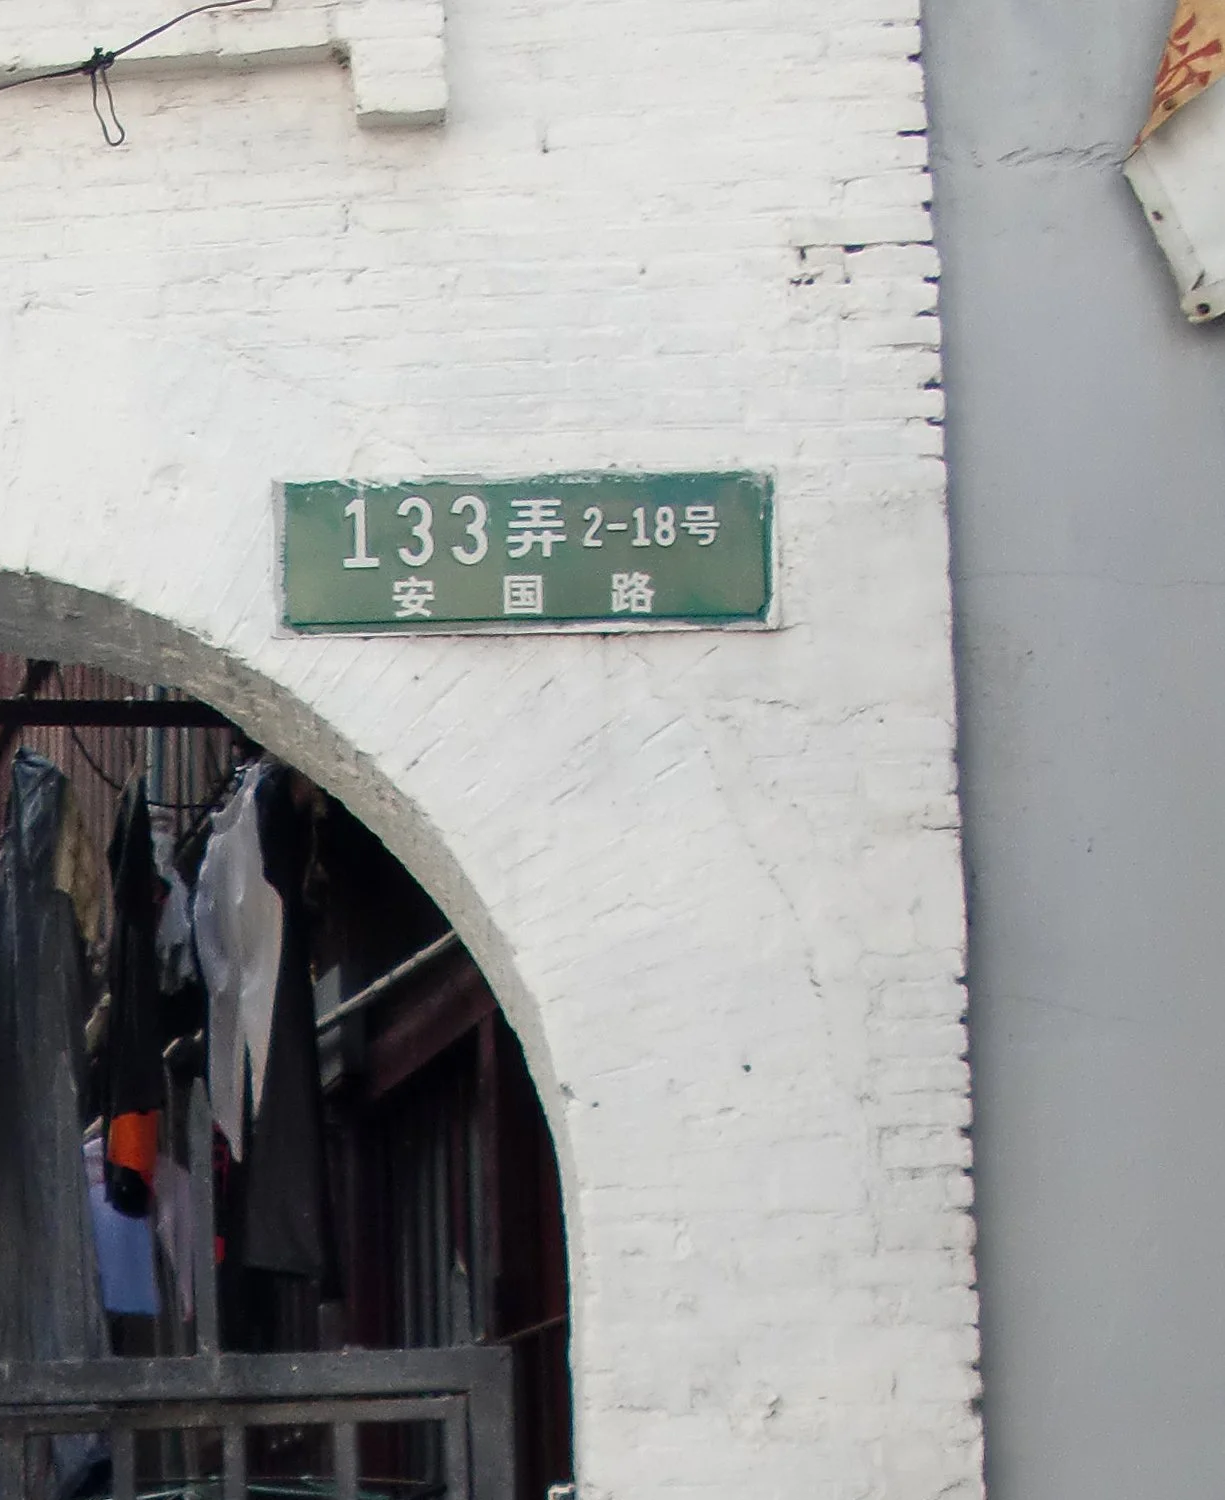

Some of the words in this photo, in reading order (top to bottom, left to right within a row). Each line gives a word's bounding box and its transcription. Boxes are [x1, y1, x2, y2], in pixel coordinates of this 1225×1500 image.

[342, 495, 568, 569] 133弄
[582, 504, 721, 548] 2-18号
[391, 570, 656, 618] 安国路
